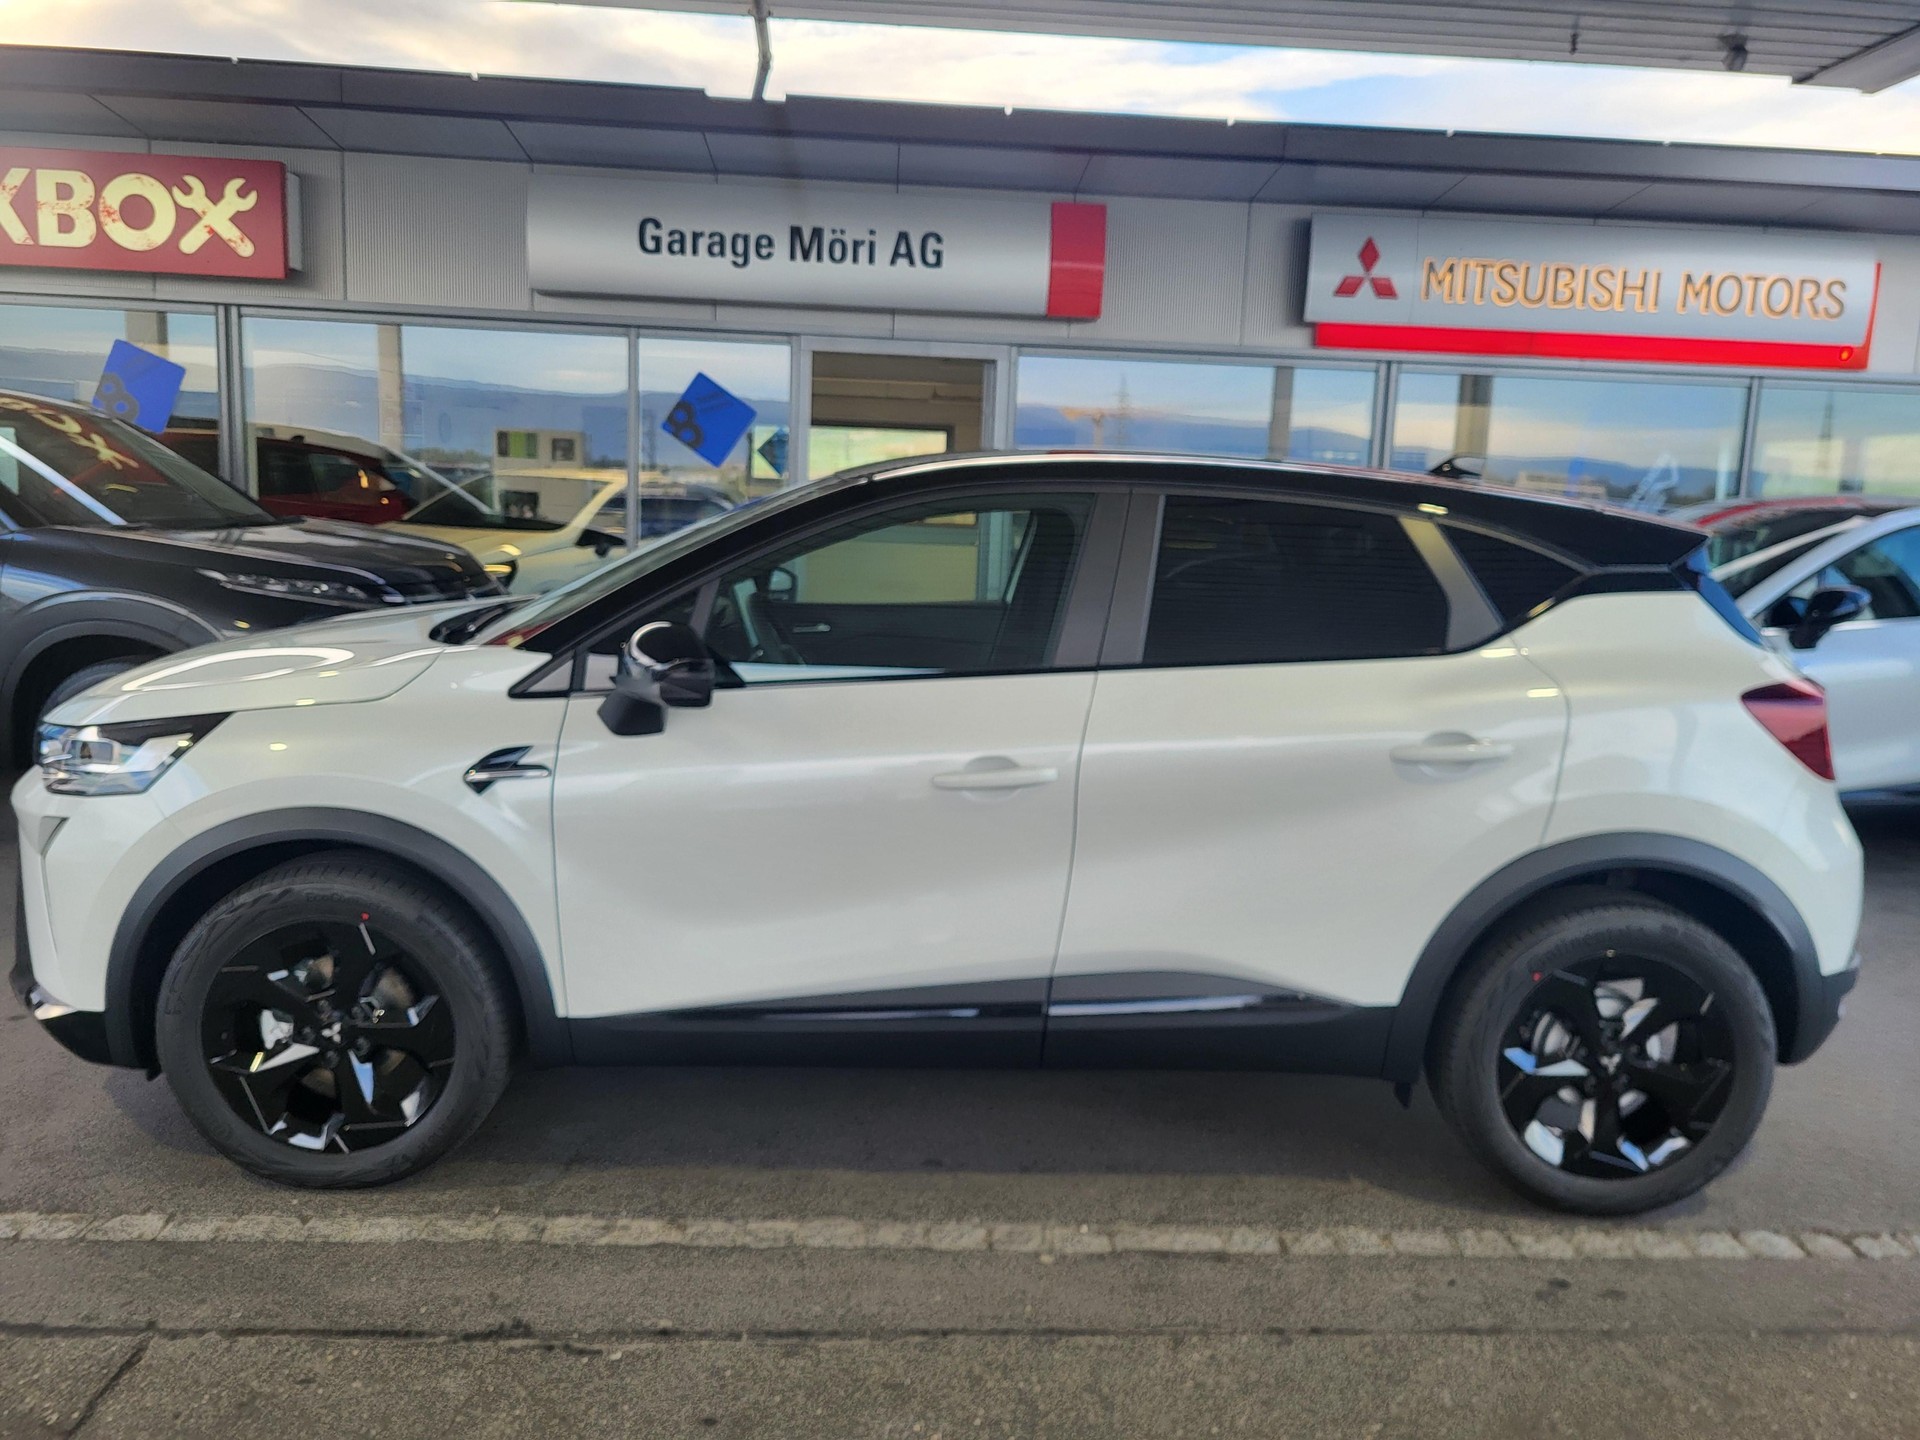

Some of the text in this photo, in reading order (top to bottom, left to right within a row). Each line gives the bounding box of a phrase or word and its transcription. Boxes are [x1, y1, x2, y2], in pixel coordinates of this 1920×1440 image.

[637, 217, 944, 269] Garage Möri AG
[1423, 257, 1848, 321] MITSUBISHI MOTORS
